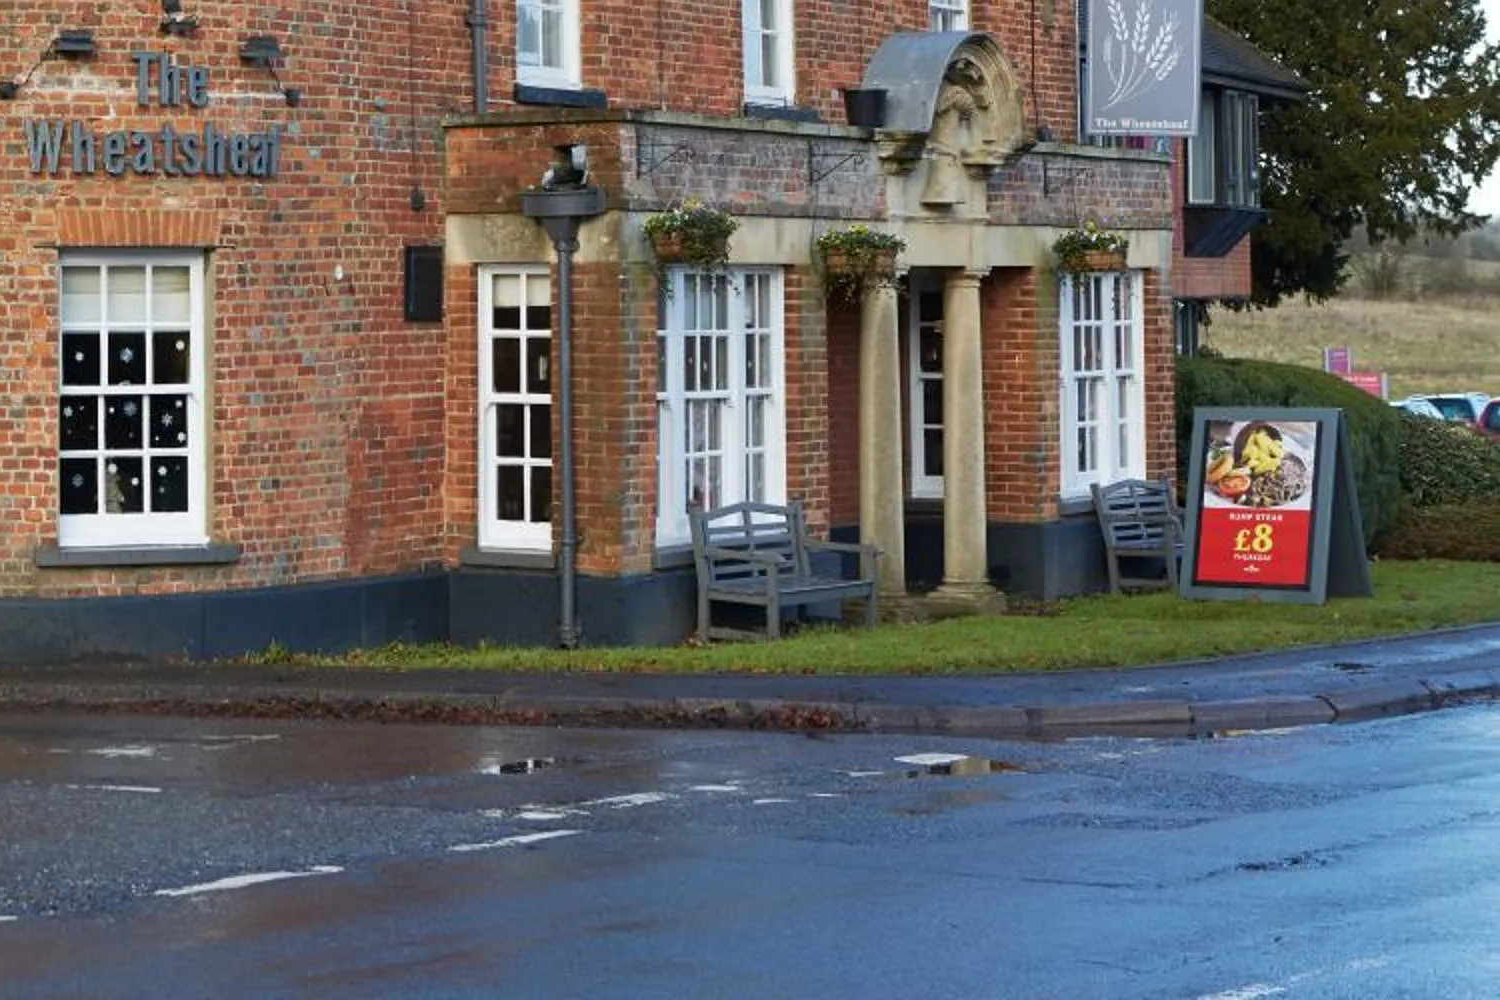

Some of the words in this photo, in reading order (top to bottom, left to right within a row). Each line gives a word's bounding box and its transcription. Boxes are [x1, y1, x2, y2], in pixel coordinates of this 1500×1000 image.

[133, 51, 210, 109] The
[1095, 117, 1117, 129] The
[1120, 118, 1189, 129] Wheatsheaf
[25, 119, 281, 178] Wheatsheaf
[1233, 523, 1273, 553] £8
